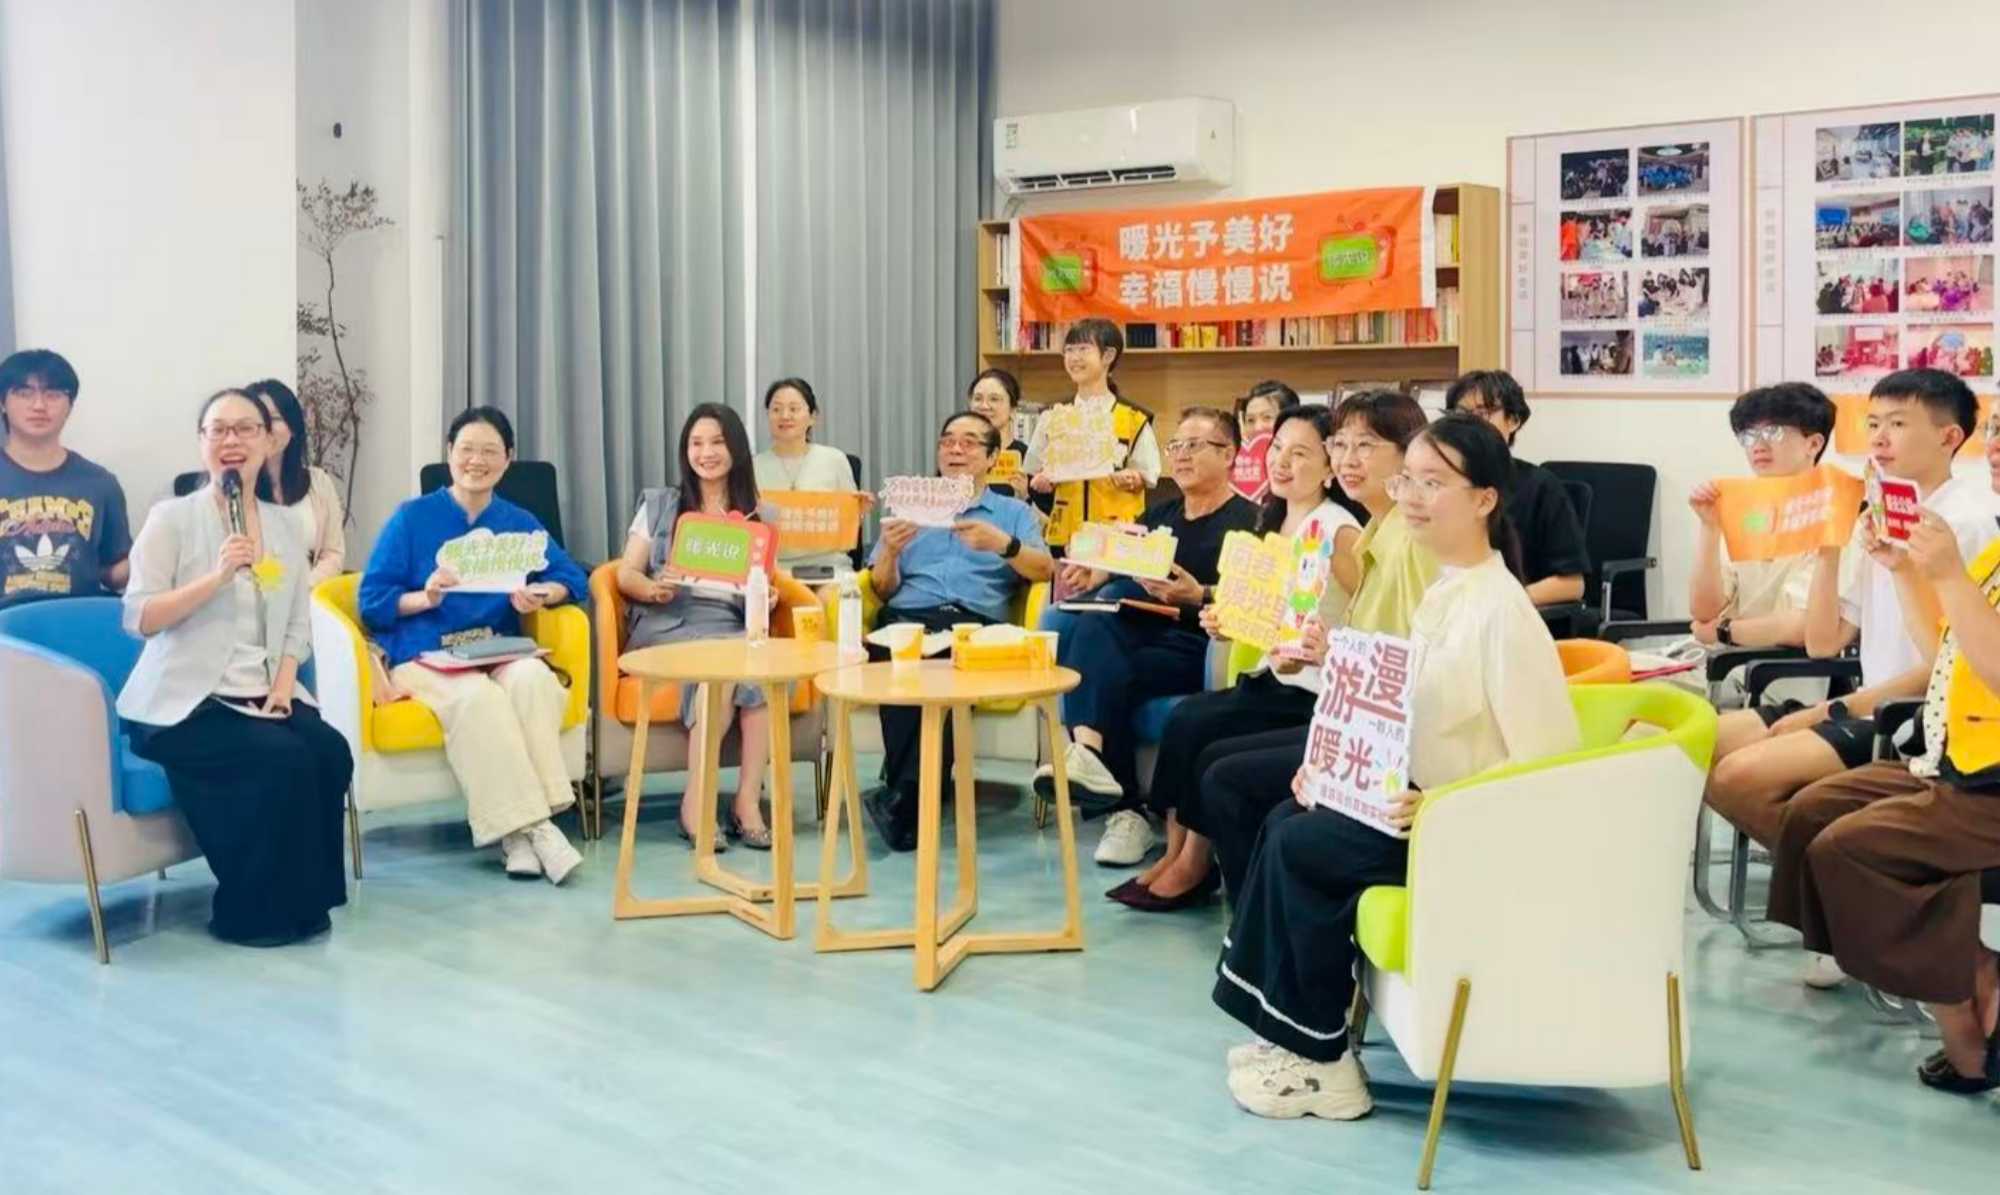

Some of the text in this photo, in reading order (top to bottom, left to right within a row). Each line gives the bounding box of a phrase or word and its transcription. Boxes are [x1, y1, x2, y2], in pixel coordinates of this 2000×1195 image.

[1118, 212, 1294, 262] 暖光予美好
[1118, 263, 1294, 310] 幸福慢慢说
[1332, 636, 1368, 657] 一个人的
[1308, 723, 1373, 791] 暖光
